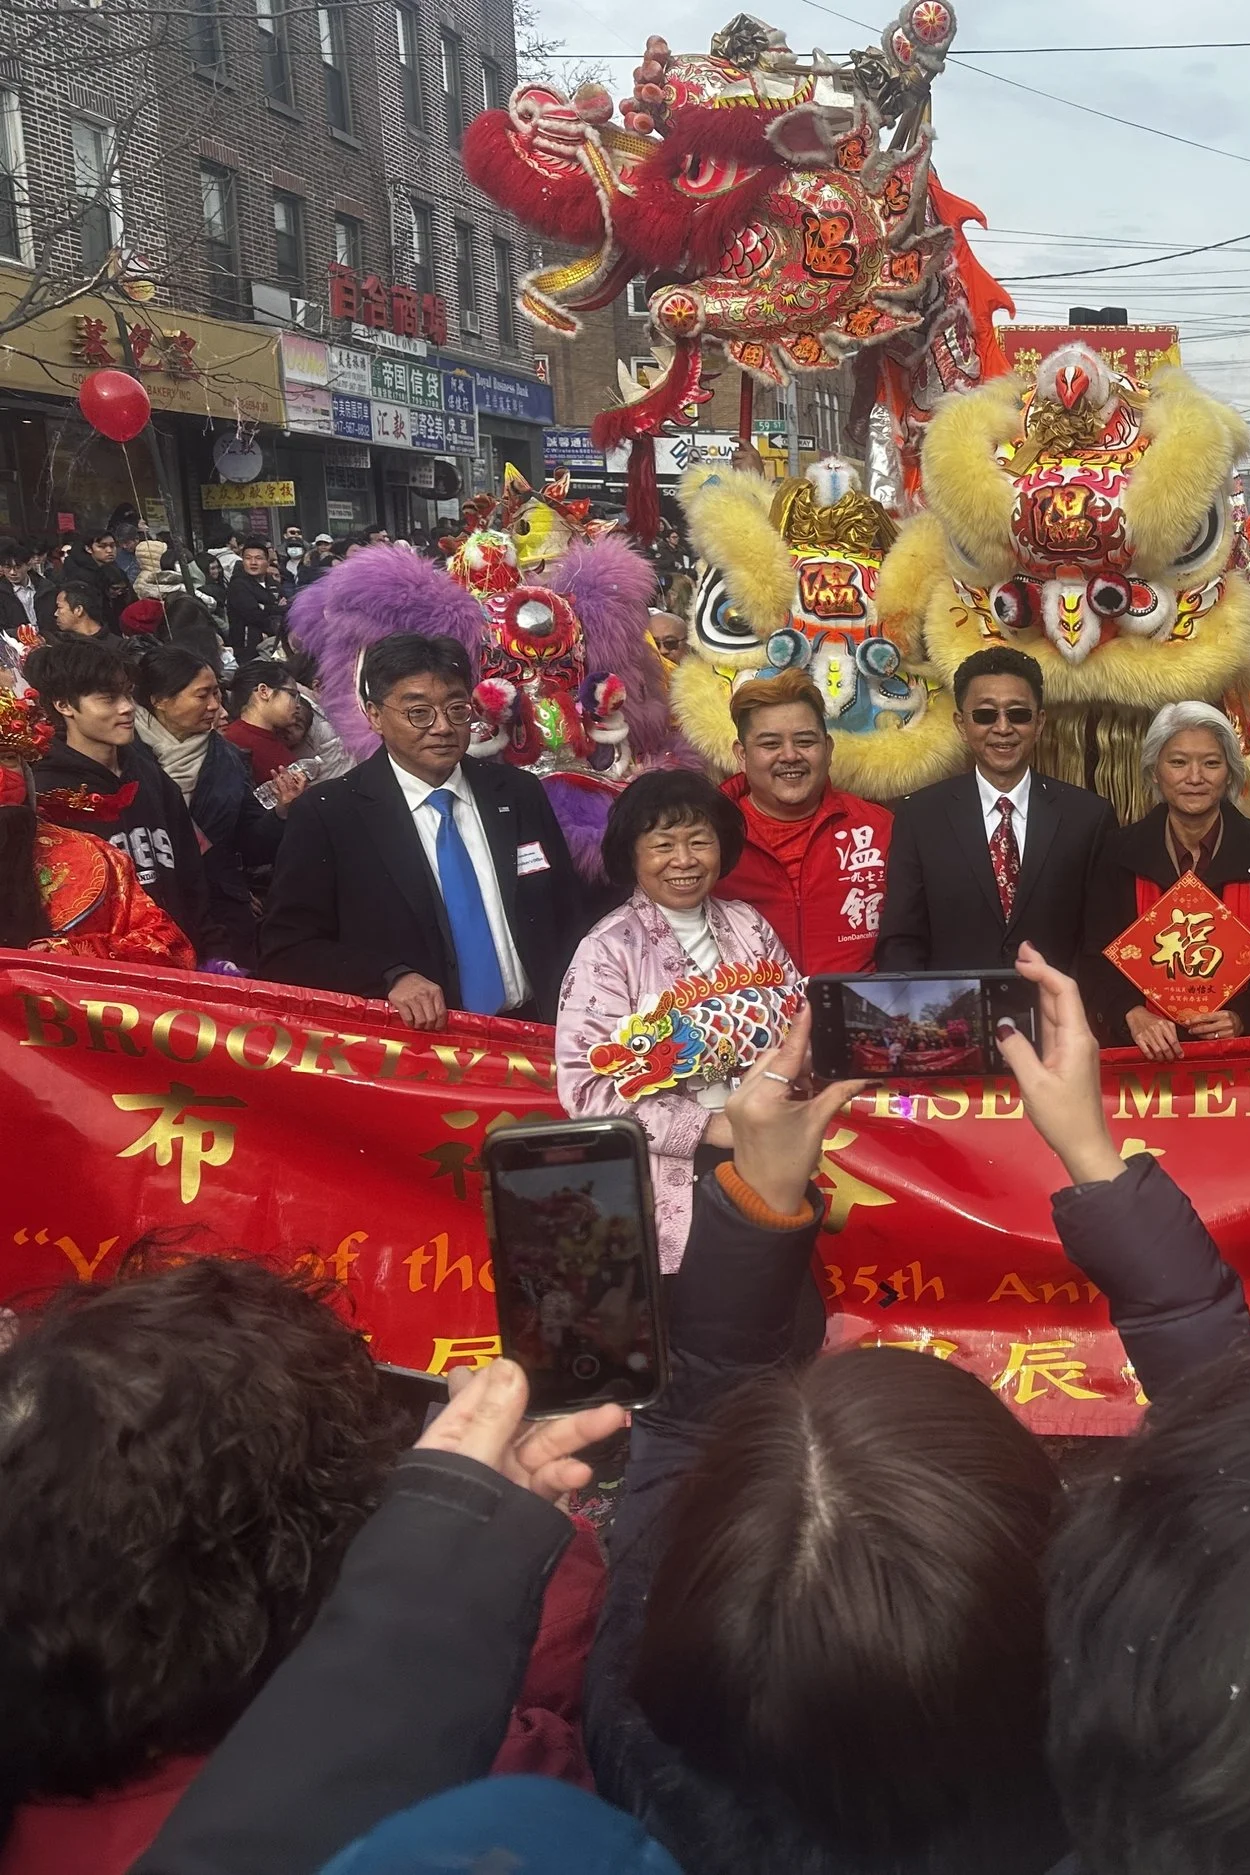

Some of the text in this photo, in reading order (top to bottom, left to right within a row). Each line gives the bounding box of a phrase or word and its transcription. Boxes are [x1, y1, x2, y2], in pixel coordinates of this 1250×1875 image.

[147, 384, 177, 399] BAKERY
[476, 372, 529, 398] Royal Business Bank
[759, 421, 782, 431] 59 ST
[1150, 908, 1224, 980] 福
[20, 995, 558, 1091] BROOKLYN
